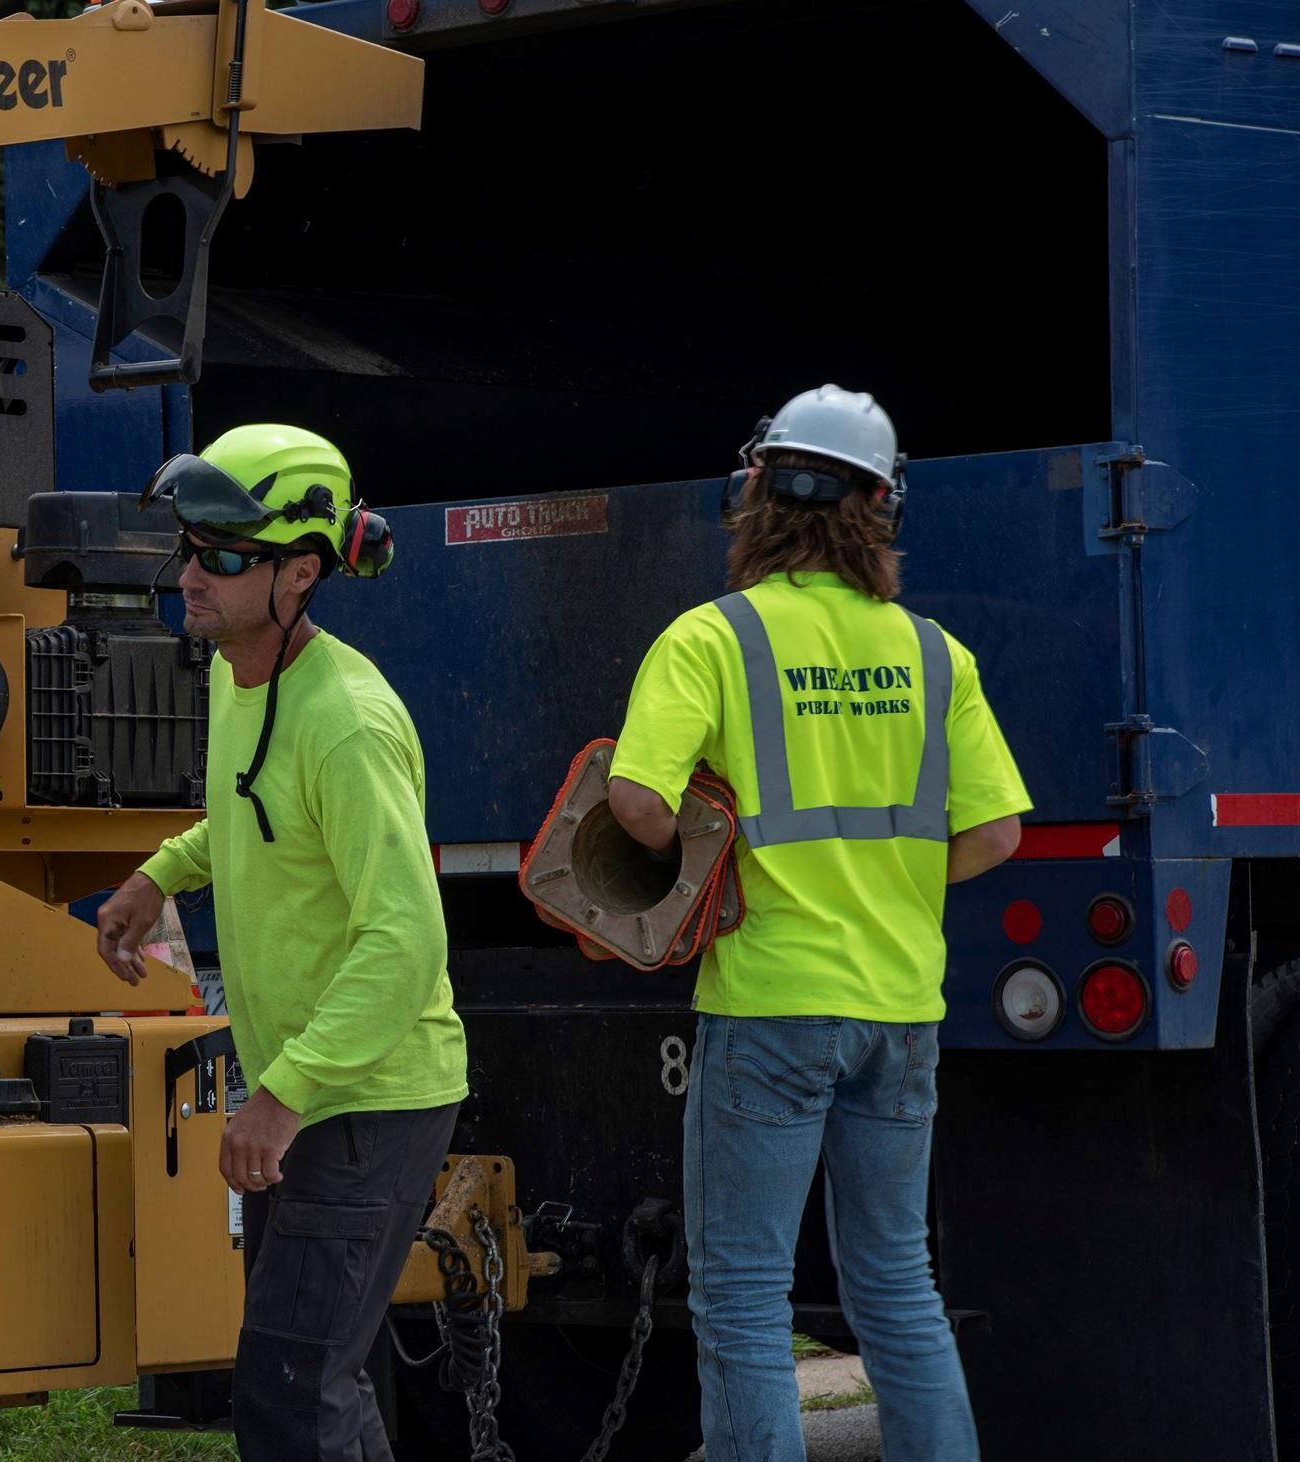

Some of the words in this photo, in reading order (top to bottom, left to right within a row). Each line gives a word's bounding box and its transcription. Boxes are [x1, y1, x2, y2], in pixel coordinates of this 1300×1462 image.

[464, 506, 520, 538] AUTO
[501, 525, 552, 537] GROUP
[784, 666, 912, 692] WHEATON
[850, 700, 910, 716] WORKS
[61, 1058, 118, 1078] Vermeer
[661, 1036, 688, 1095] 8
